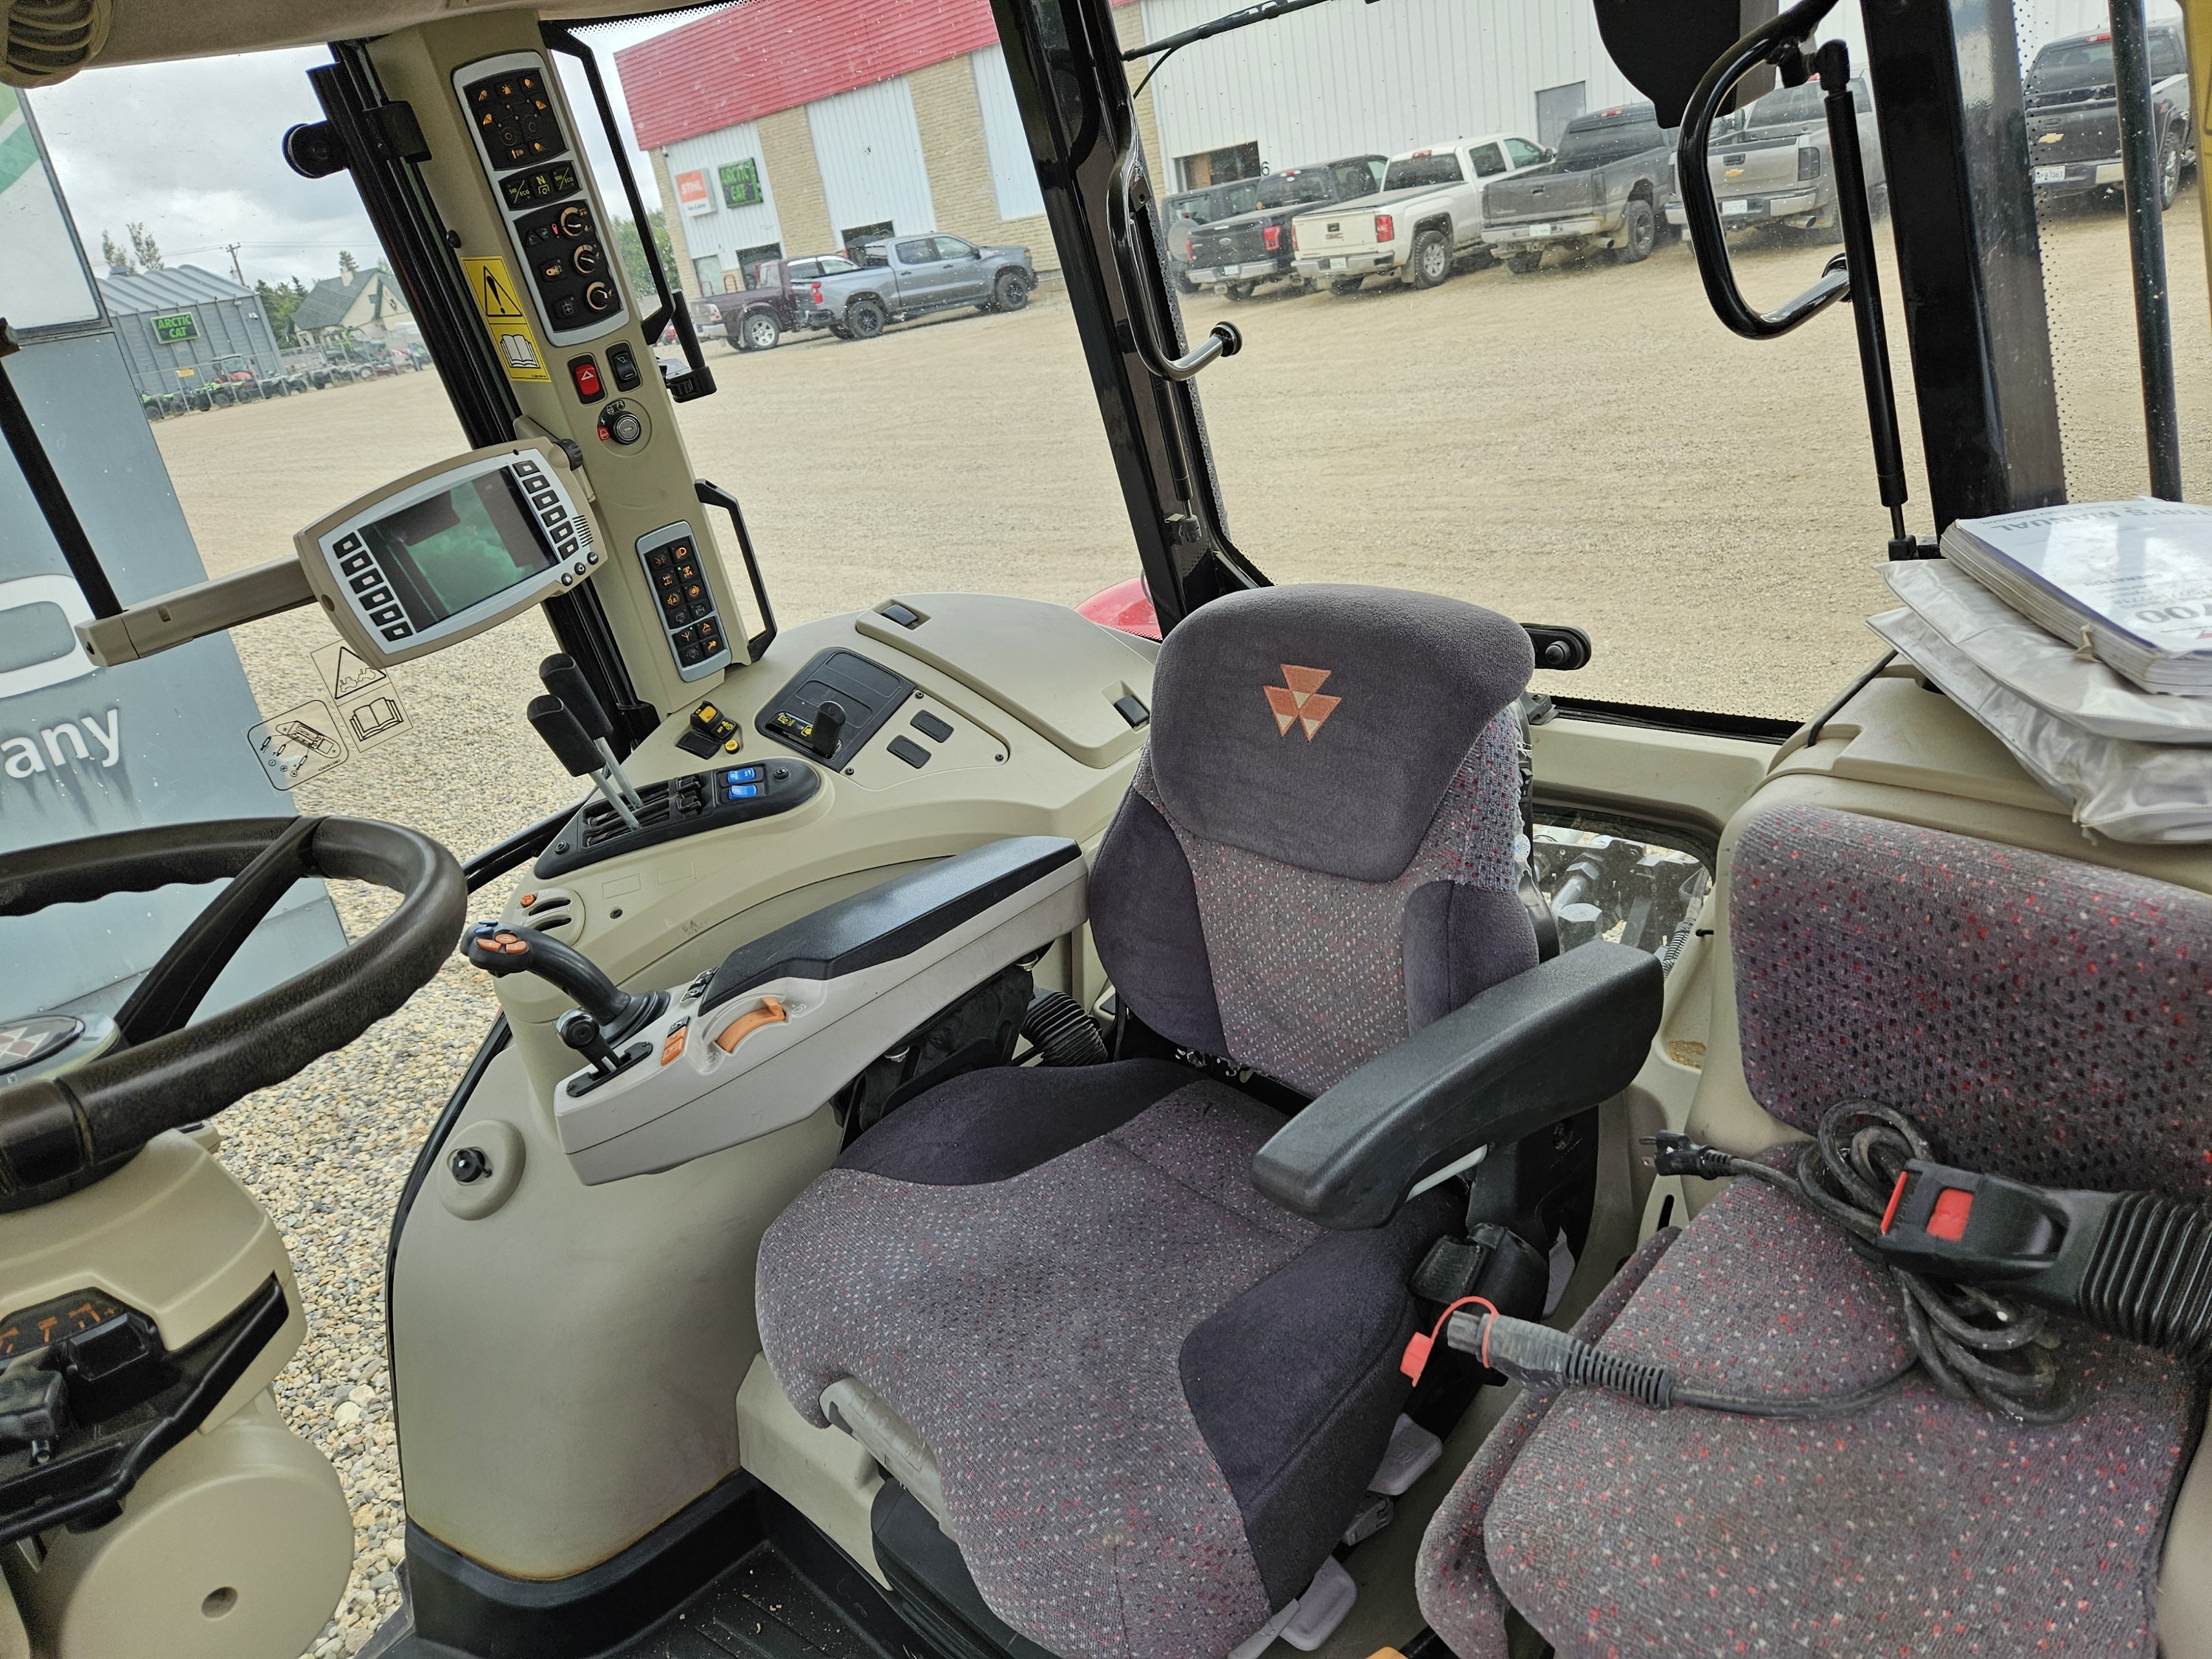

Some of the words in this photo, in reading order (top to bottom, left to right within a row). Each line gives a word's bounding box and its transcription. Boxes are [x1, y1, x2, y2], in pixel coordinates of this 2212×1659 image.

[1261, 161, 1269, 175] 6
[536, 175, 546, 185] N
[720, 167, 751, 184] ARCTIC
[681, 181, 702, 195] STIHL
[158, 315, 192, 330] ARCTIC
[169, 327, 187, 338] CAT
[1991, 510, 2121, 532] MANUAL
[0, 708, 119, 779] any
